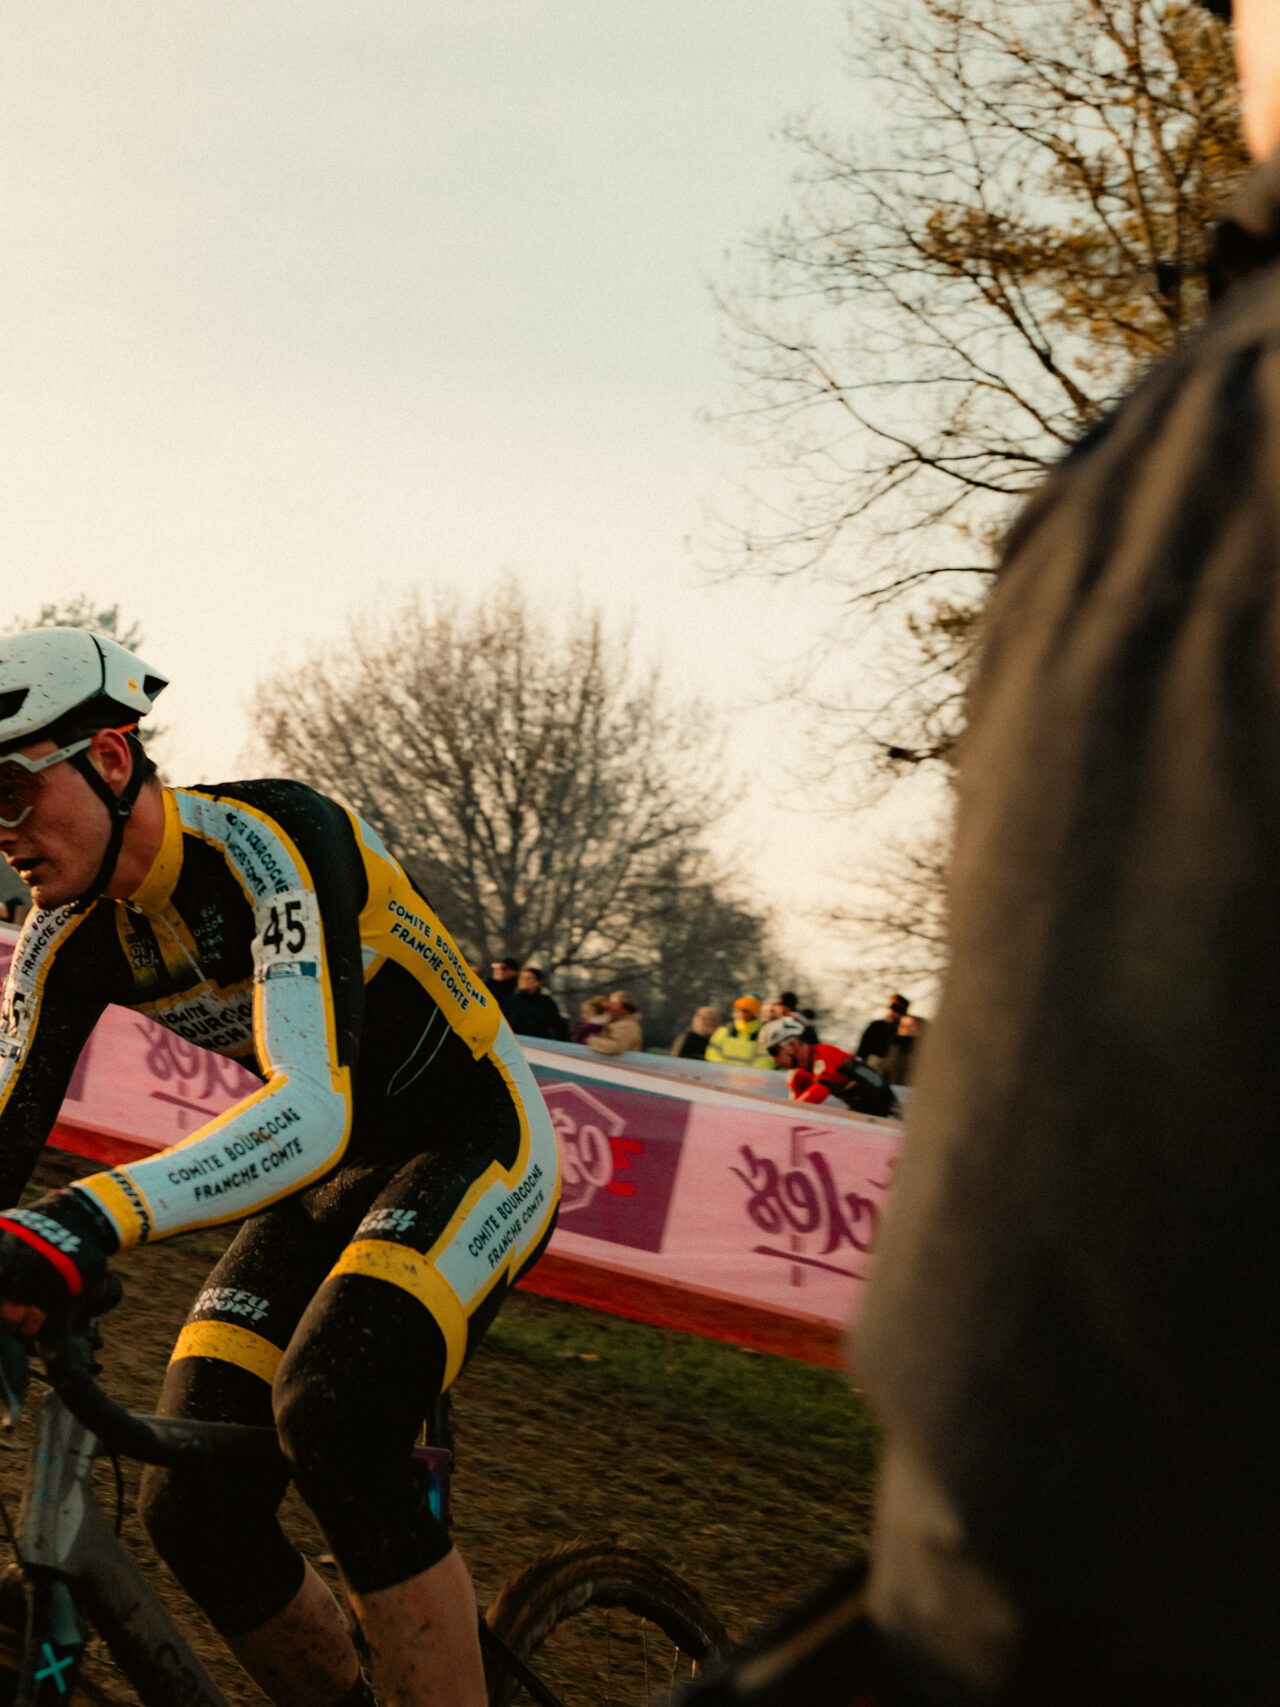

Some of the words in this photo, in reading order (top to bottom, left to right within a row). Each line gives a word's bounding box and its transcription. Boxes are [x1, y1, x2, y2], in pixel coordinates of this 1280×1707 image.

[262, 900, 307, 955] 45
[387, 900, 432, 938] COMITE
[390, 923, 443, 972] FRANCHE
[440, 970, 470, 1011] COMTE
[168, 1154, 224, 1184] COMITE
[194, 1163, 260, 1201] FRANCHE
[261, 1137, 304, 1172] COMTE
[468, 1214, 500, 1257] COMITE
[488, 1219, 522, 1269] FRANCHE
[522, 1189, 545, 1224] COMTE
